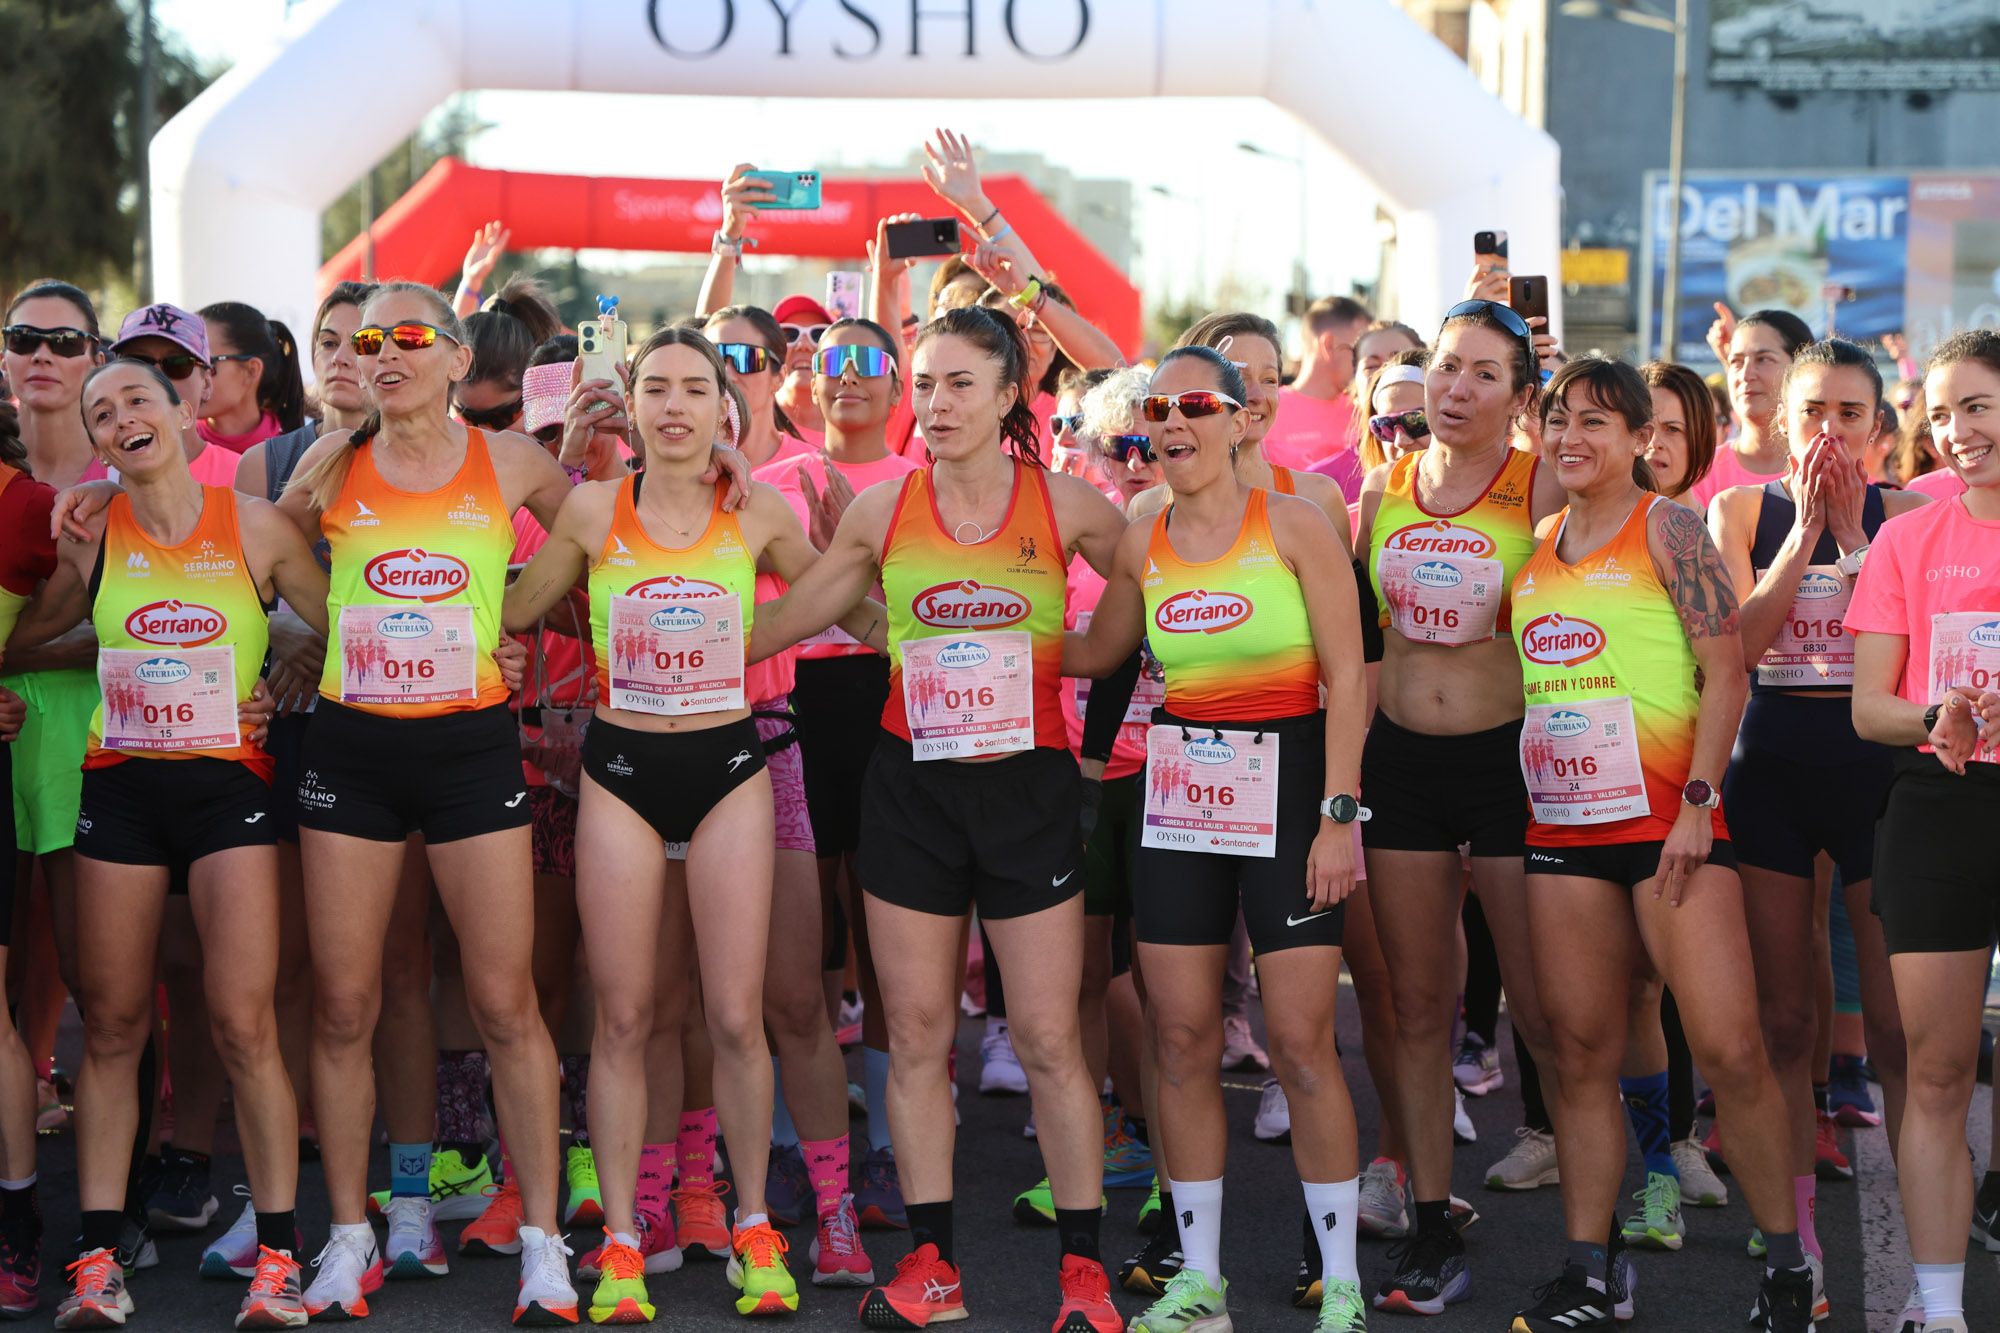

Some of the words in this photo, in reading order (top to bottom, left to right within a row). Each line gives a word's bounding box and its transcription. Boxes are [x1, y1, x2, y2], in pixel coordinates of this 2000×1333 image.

[645, 0, 1093, 62] OYSHO
[1656, 184, 1759, 241] Del
[1776, 184, 1908, 241] Mar
[139, 306, 182, 334] NY
[1488, 492, 1524, 503] SERRANO
[448, 511, 490, 523] SERRANO
[1392, 532, 1486, 554] Serrano
[184, 560, 235, 573] SERRANO
[374, 563, 462, 586] Serrano
[1415, 571, 1459, 583] ASTURIANA
[1584, 572, 1632, 582] SERRANO
[1797, 585, 1838, 593] STURIANA
[922, 596, 1022, 619] Serrano
[1162, 602, 1243, 625] Serrano
[653, 615, 701, 626] ASTURIANA
[1413, 606, 1459, 628] 016
[136, 614, 218, 634] Serrano
[382, 622, 429, 633] ASTURIANA
[1793, 619, 1843, 639] 016
[1425, 631, 1436, 640] 21
[1529, 631, 1597, 653] Serrano
[1803, 643, 1827, 652] 6830
[655, 650, 704, 670] 016
[940, 653, 987, 663] ASTURIANA
[1803, 655, 1810, 663] LA
[139, 668, 187, 678] ASTURIANA
[384, 659, 435, 679] 016
[1768, 669, 1803, 679] OYSHO
[671, 675, 683, 683] 18
[1544, 679, 1567, 692] BIEN
[1571, 678, 1577, 690] Y
[1580, 676, 1616, 690] CORRE
[400, 685, 413, 693] 17
[627, 682, 653, 693] CARRERA
[655, 684, 662, 693] DE
[664, 685, 672, 693] LA
[674, 684, 694, 693] MUJER
[698, 681, 726, 691] VALENCIA
[356, 696, 382, 704] CARRERA
[403, 696, 425, 704] MUJER
[430, 693, 459, 702] VALENCIA
[625, 693, 665, 708] OYSHO
[690, 695, 728, 706] Santander
[945, 687, 994, 709] 016
[143, 703, 194, 724] 016
[962, 714, 974, 722] 22
[922, 729, 946, 737] CARRERA
[947, 727, 955, 735] DE
[966, 724, 986, 733] MUJER
[992, 721, 1016, 730] VALENCIA
[1547, 722, 1587, 731] ASTURIANA
[160, 729, 172, 738] 15
[118, 740, 144, 748] CARRERA
[145, 740, 152, 748] DE
[154, 740, 162, 748] LA
[163, 739, 185, 748] MUJER
[190, 737, 221, 747] VALENCIA
[922, 741, 958, 752] OYSHO
[984, 736, 1021, 746] Santander
[1188, 746, 1231, 759] ASTURIANA
[607, 762, 634, 773] SERRANO
[1554, 756, 1598, 777] 016
[1569, 782, 1580, 791] 24
[1187, 784, 1234, 805] 016
[1573, 793, 1592, 801] MUJER
[1597, 789, 1627, 799] VALENCIA
[1201, 810, 1212, 819] 19
[1542, 807, 1570, 817] OYSHO
[1592, 804, 1632, 816] Santander
[1159, 818, 1185, 827] CARRERA
[1186, 820, 1194, 828] DE
[1204, 822, 1224, 830] MUJER
[1229, 823, 1258, 832] VALENCIA
[1156, 831, 1195, 844] OYSHO
[1220, 838, 1259, 848] Santander
